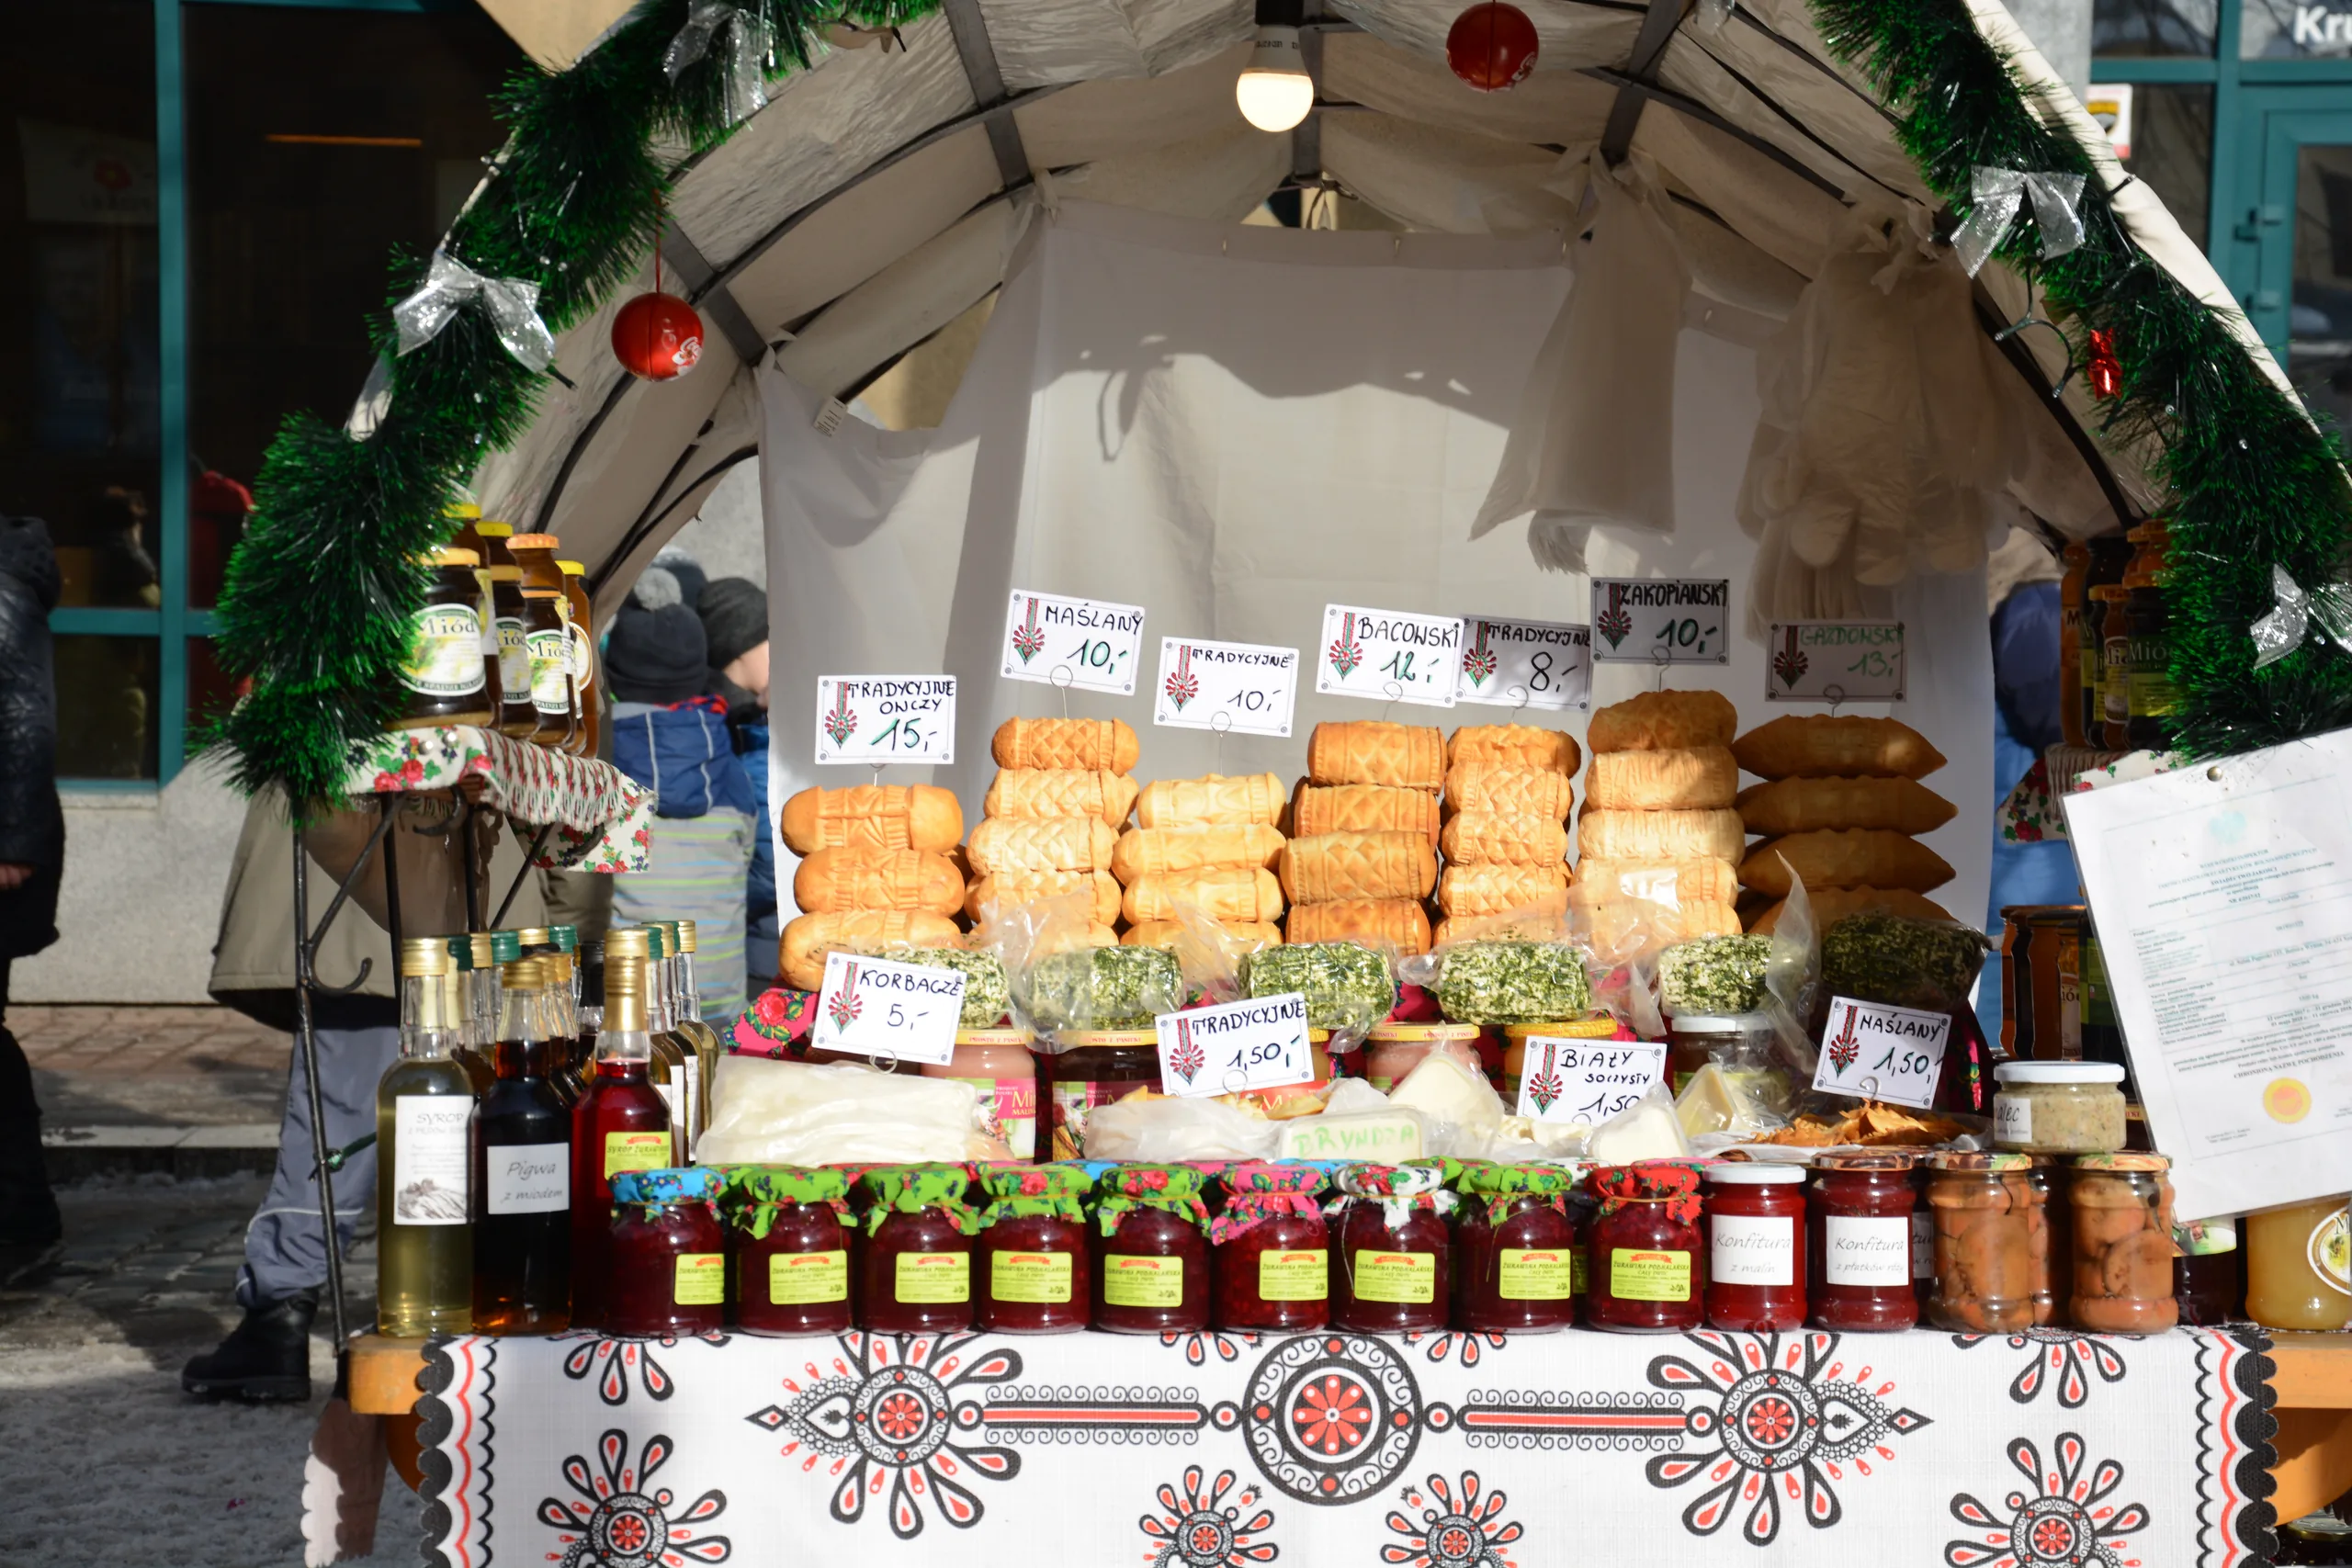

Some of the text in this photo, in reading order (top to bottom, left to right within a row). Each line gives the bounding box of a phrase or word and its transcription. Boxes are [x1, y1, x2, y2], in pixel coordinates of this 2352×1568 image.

[1045, 603, 1144, 635] MAŚLANY
[1192, 648, 1290, 669] TRADYCYJNE
[847, 680, 956, 698] TRADYCYJNE
[860, 969, 963, 996] KORBACZE
[1192, 1001, 1305, 1035] TRADYCYJNE
[506, 1160, 556, 1180] Pigwa
[1714, 1233, 1792, 1250] Konfitura
[1836, 1236, 1905, 1251] Konfitura
[1730, 1262, 1775, 1273] z malin
